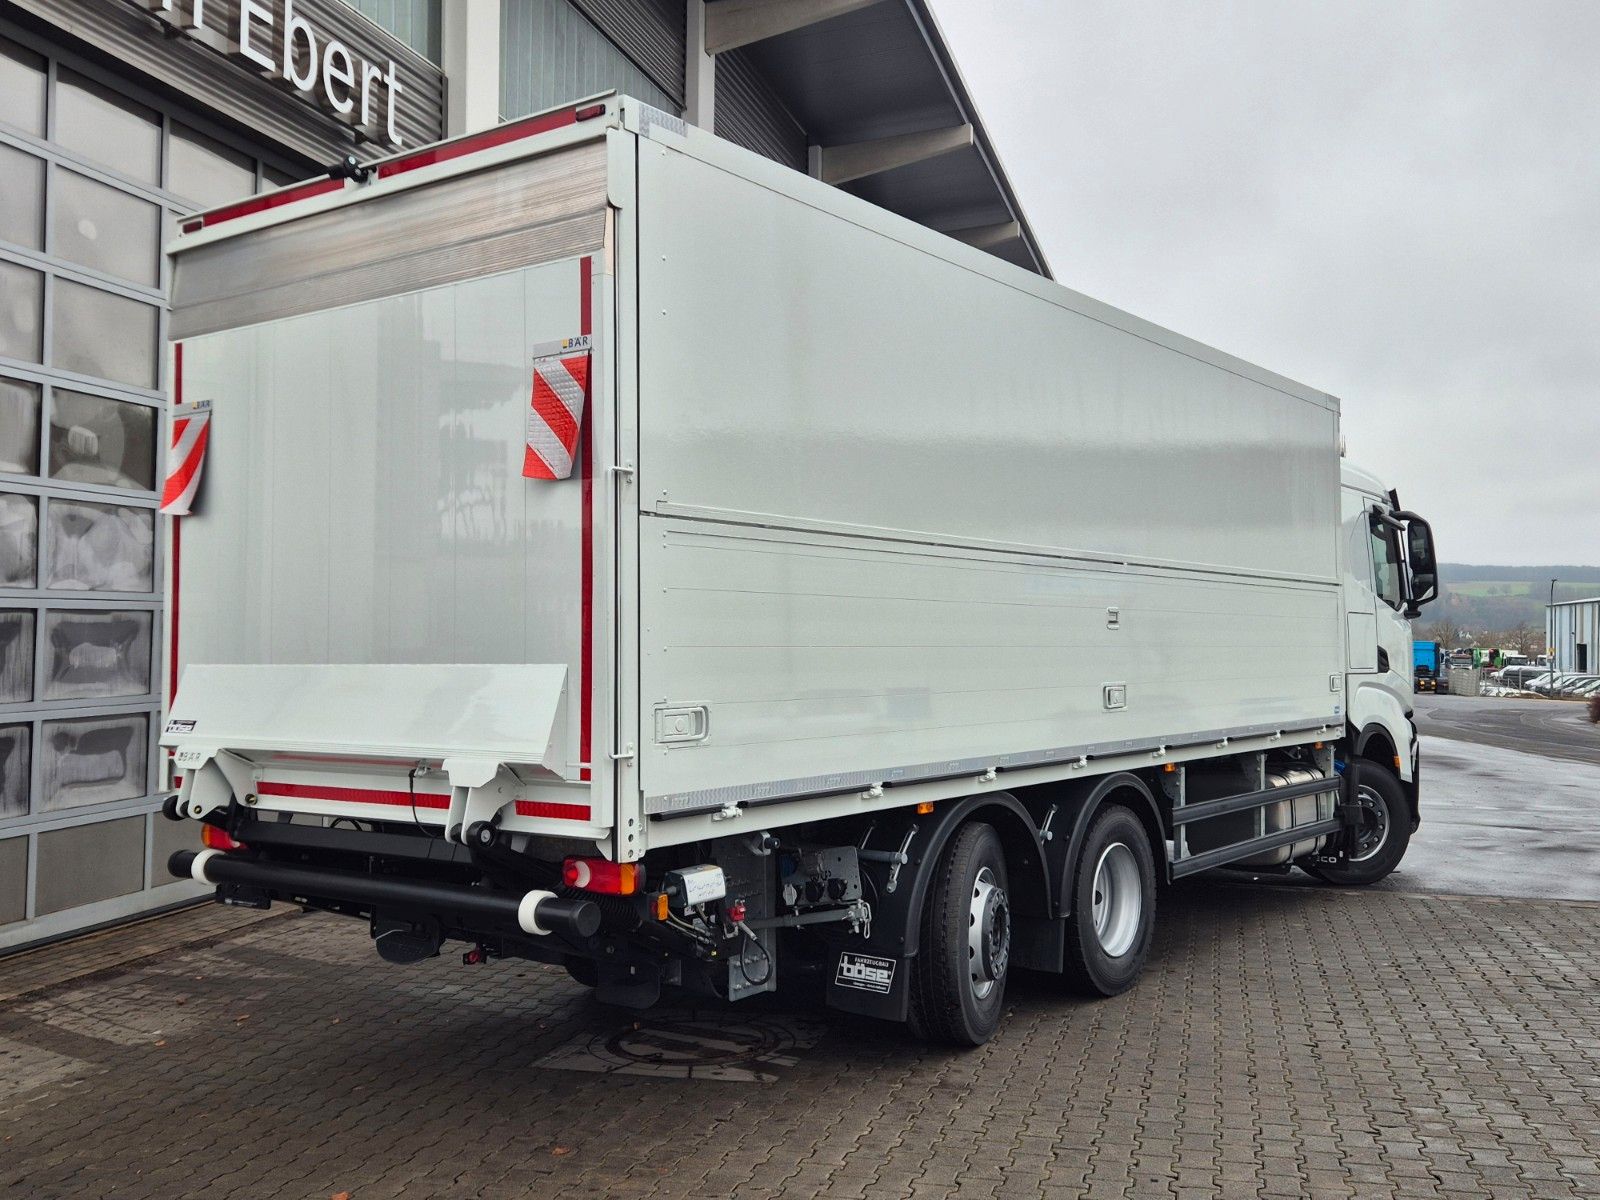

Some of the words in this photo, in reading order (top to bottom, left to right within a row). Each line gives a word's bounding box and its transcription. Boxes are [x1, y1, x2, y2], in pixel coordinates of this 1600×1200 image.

[240, 0, 402, 145] Ebert
[568, 336, 589, 348] BÄR
[841, 955, 890, 983] böse
